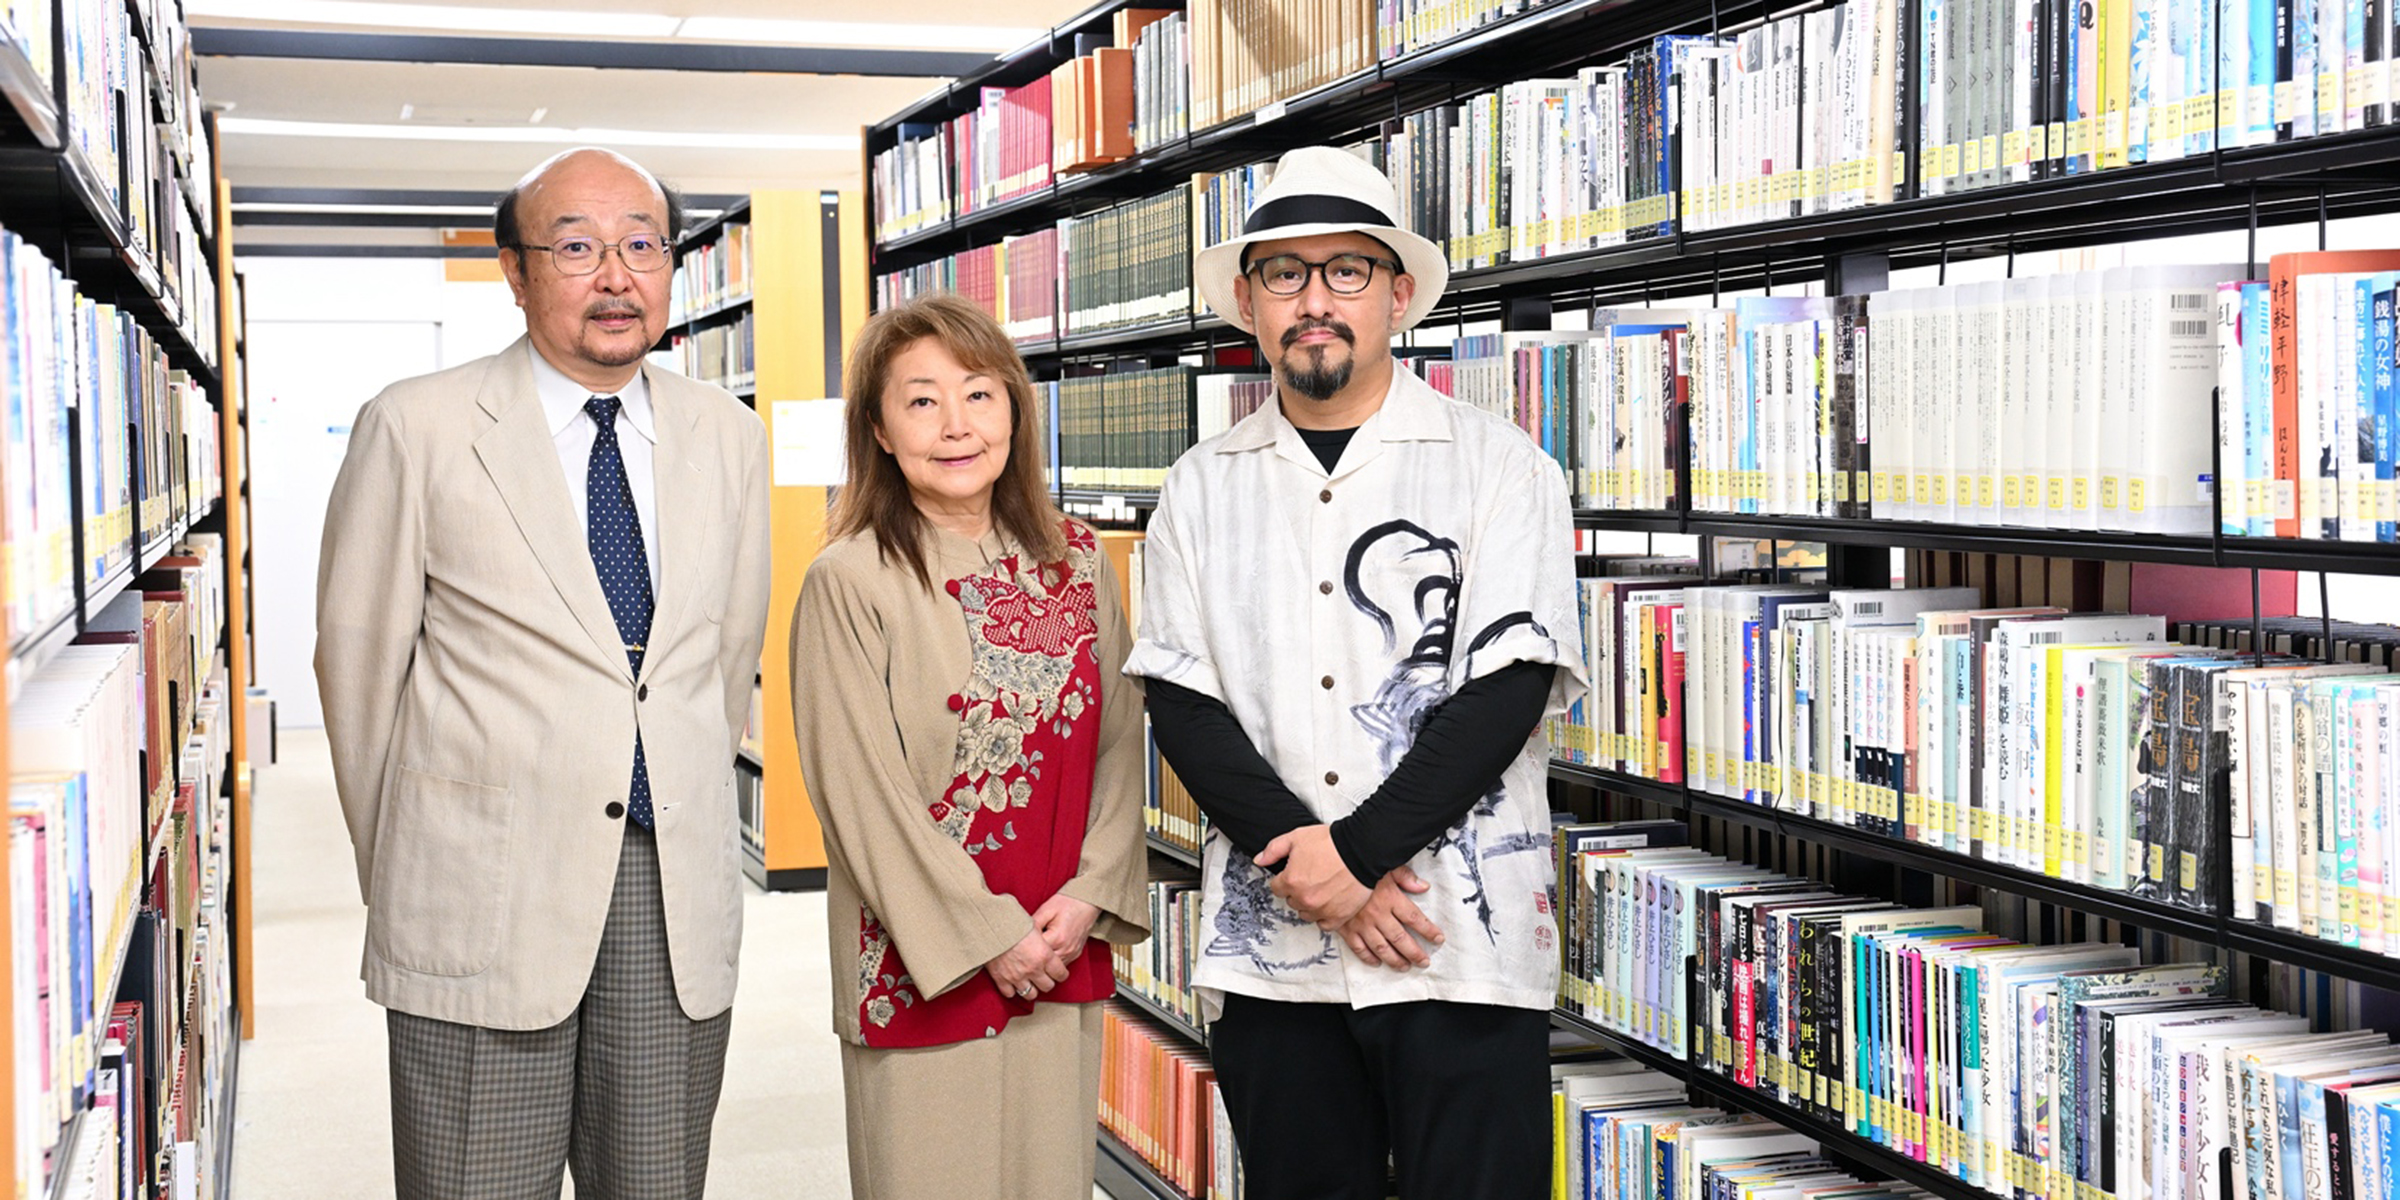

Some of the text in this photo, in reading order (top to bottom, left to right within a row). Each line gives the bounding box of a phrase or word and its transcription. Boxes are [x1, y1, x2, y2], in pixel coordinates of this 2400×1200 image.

[2273, 276, 2291, 395] 津軽平野
[2374, 300, 2391, 391] 銭湯の女神
[2278, 427, 2288, 480] ほんま
[2377, 414, 2388, 462] 星野博美
[2151, 685, 2169, 768] 宝島
[2183, 689, 2201, 773] 宝島
[2339, 784, 2349, 829] 角田光代
[1800, 921, 1816, 1068] われらの世紀
[1755, 1020, 1767, 1088] 真藤丈
[2116, 1039, 2124, 1088] 送り火
